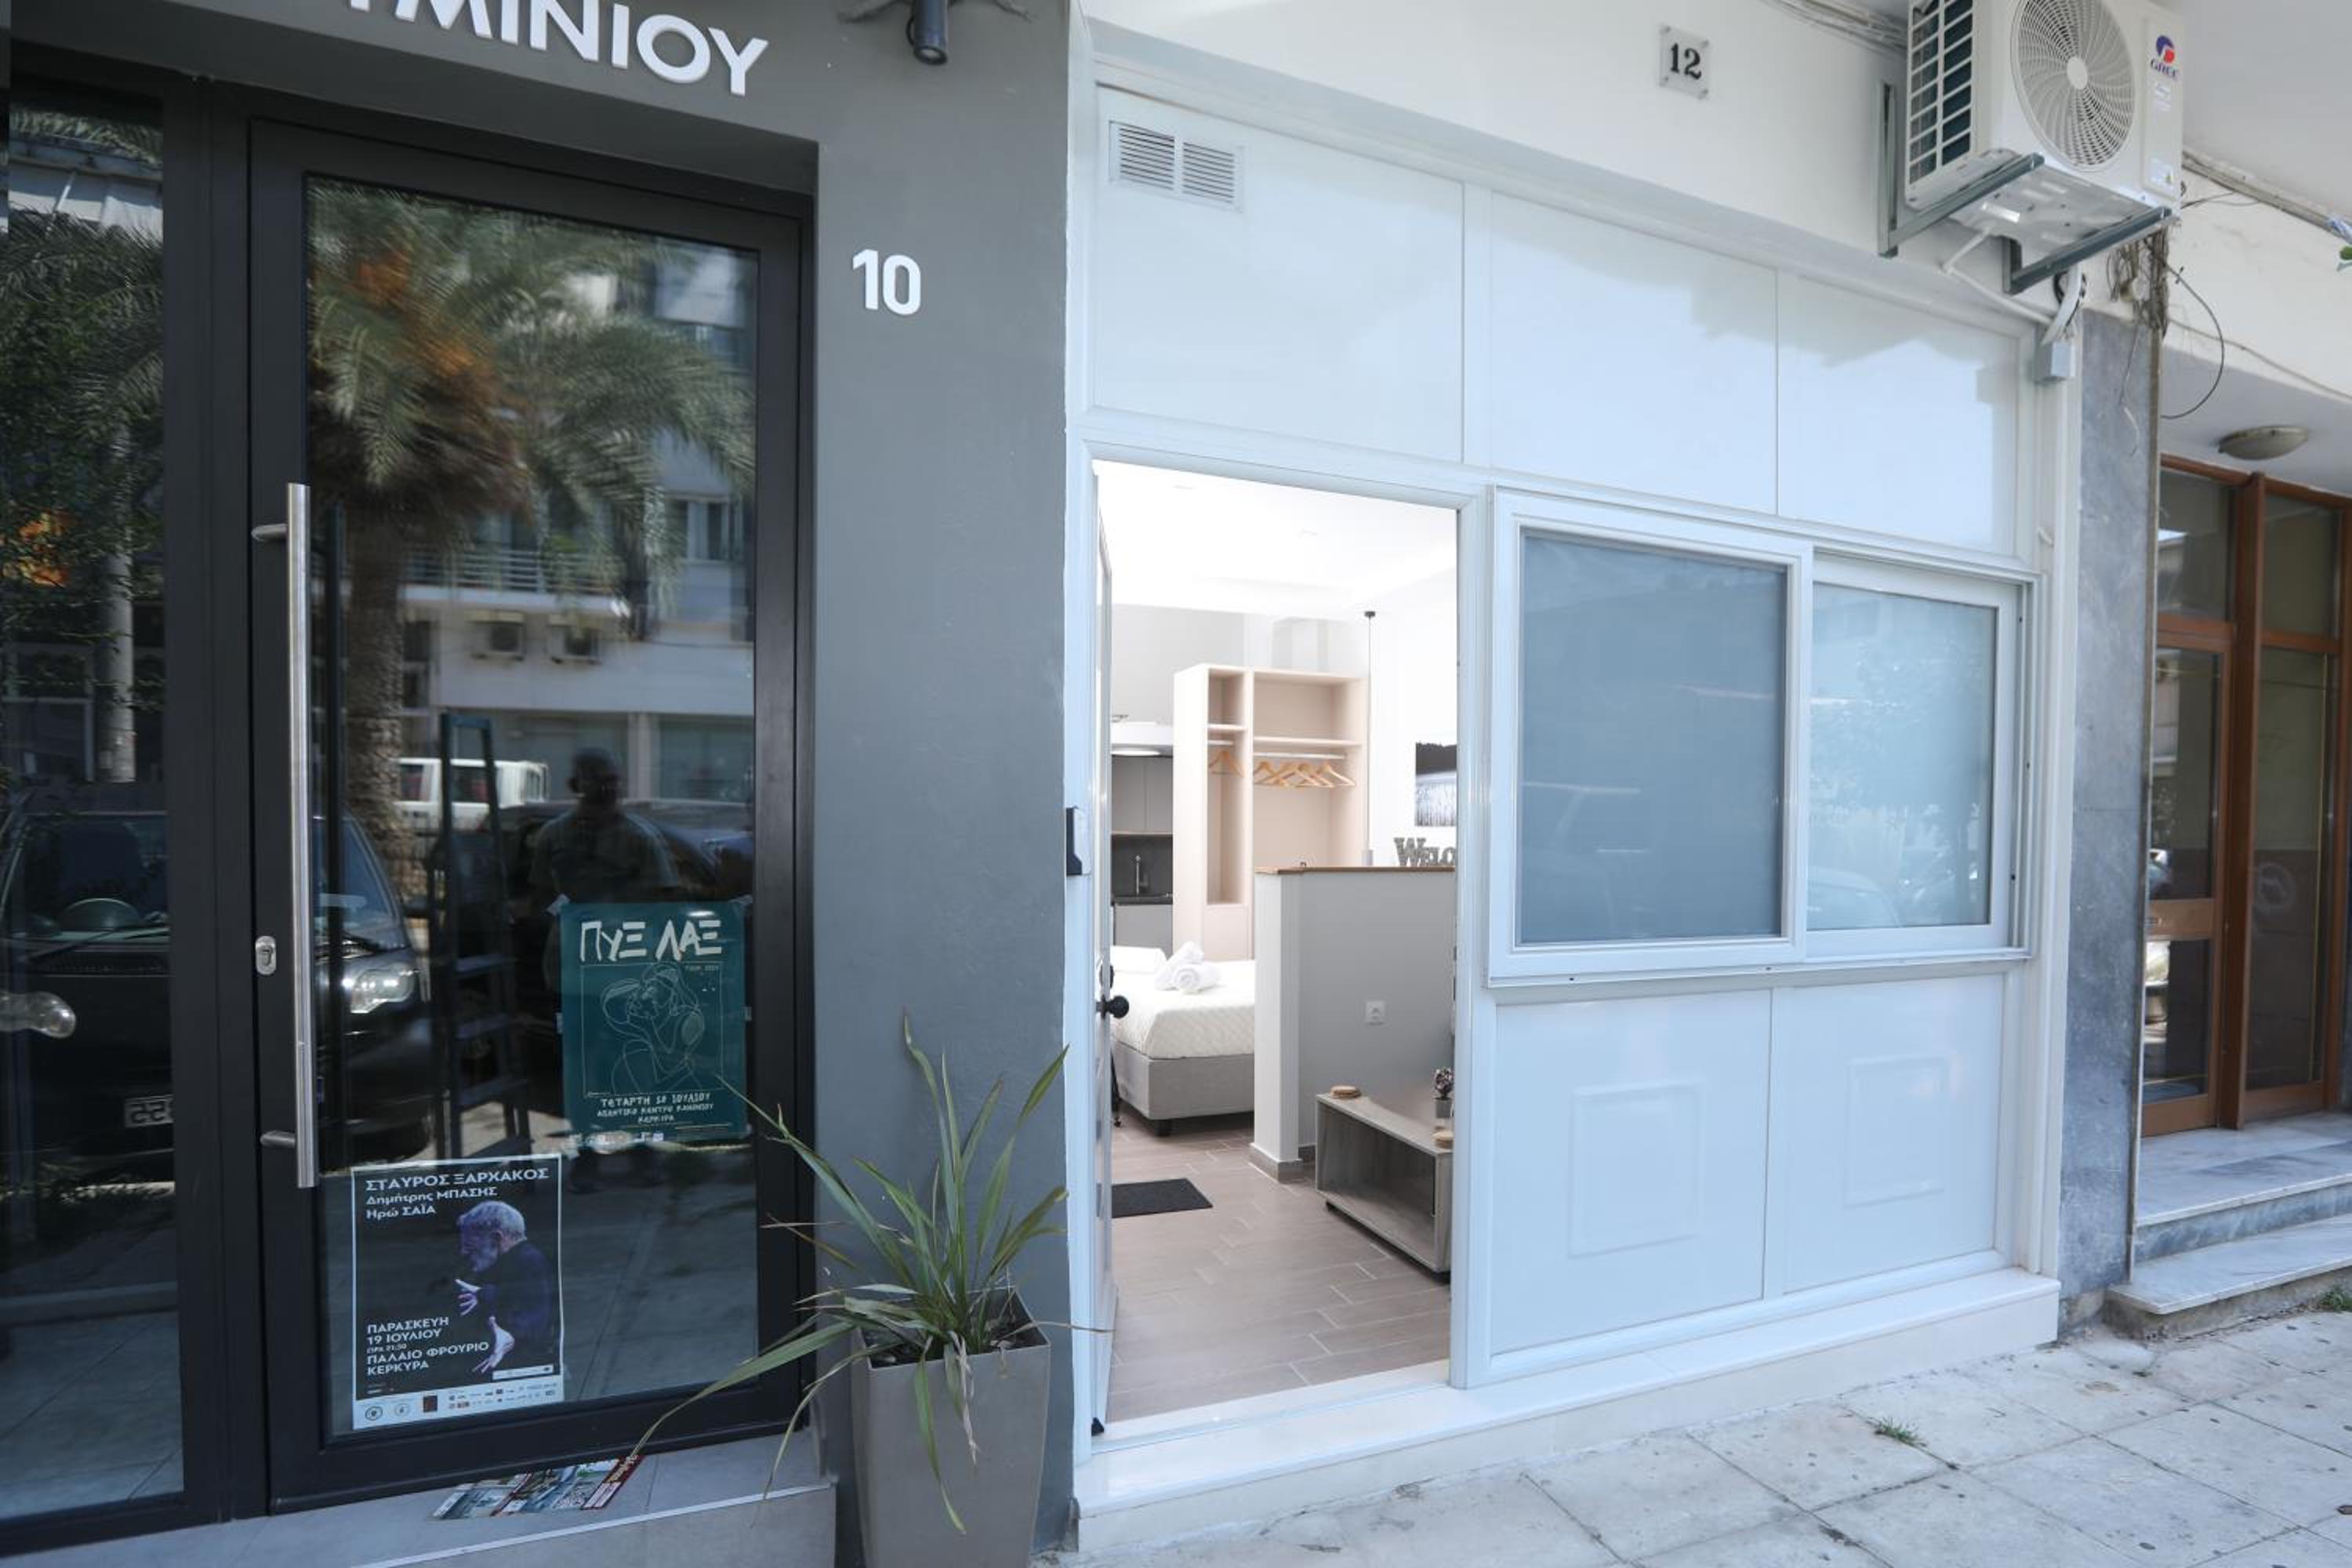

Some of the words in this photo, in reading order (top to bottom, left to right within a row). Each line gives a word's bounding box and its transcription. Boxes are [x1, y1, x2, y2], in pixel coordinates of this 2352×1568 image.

[1670, 42, 1702, 80] 12
[852, 249, 921, 315] 10
[365, 1174, 450, 1192] ΣΤΑΥΡΟΣ
[453, 1167, 550, 1185] ΞΑΡΧΑΚΟΣ
[365, 1192, 434, 1206] Δημήτρης
[437, 1186, 498, 1200] ΜΠΑΣΗΣ
[366, 1209, 399, 1221] Ηρώ
[402, 1204, 437, 1216] ΣΑΪΑ
[367, 1316, 449, 1334] ΠΑΡΑΣΚΕΥΗ
[367, 1335, 382, 1345] 19
[386, 1328, 443, 1343] ΙΟΥΛΙΟΥ
[367, 1349, 423, 1365] ΠΑΛΑΙΟ
[426, 1341, 489, 1357] ΦΡΟΥΡΙΟ
[367, 1360, 429, 1376] ΚΕΡΚΥΡΑ
